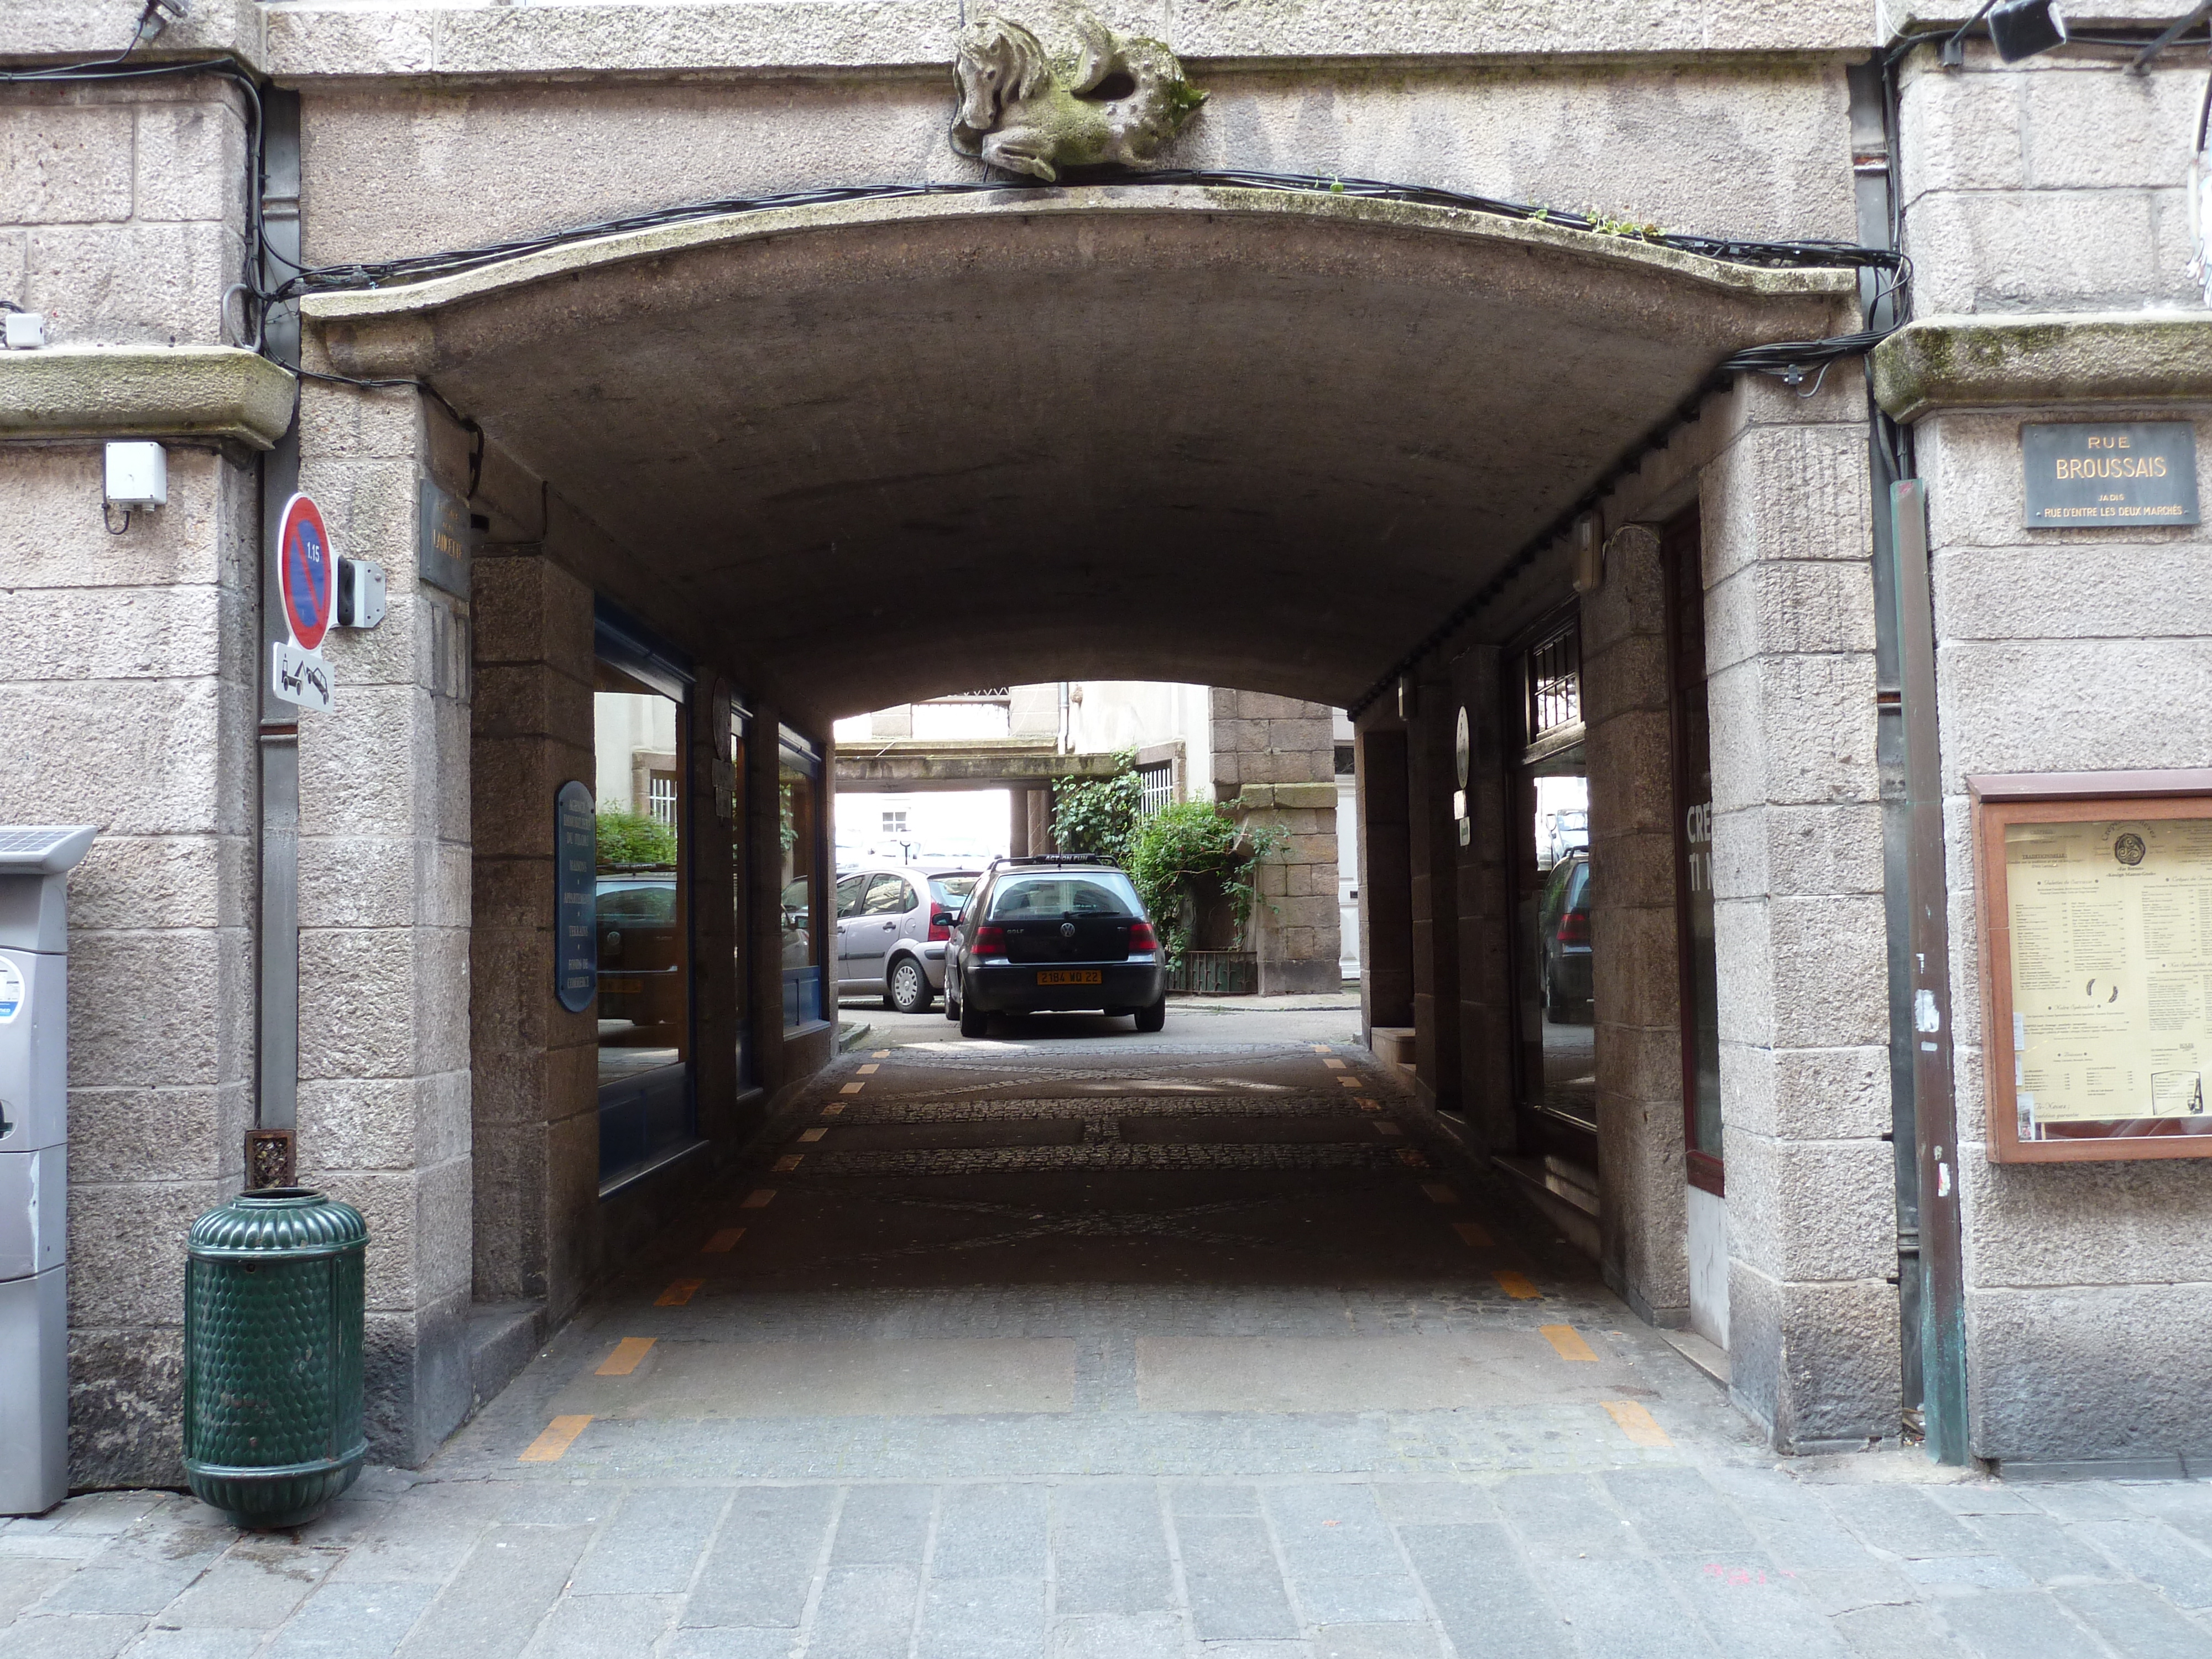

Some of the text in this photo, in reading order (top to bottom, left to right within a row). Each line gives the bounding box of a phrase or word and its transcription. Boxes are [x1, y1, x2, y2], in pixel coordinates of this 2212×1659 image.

[2088, 436, 2131, 449] RUE
[2056, 456, 2167, 480] BROUSSAIS
[2044, 504, 2183, 518] RUE D'ENTRE LES DEUX MARCHÉS
[307, 541, 320, 562] 1.15
[1086, 972, 1098, 982] 22
